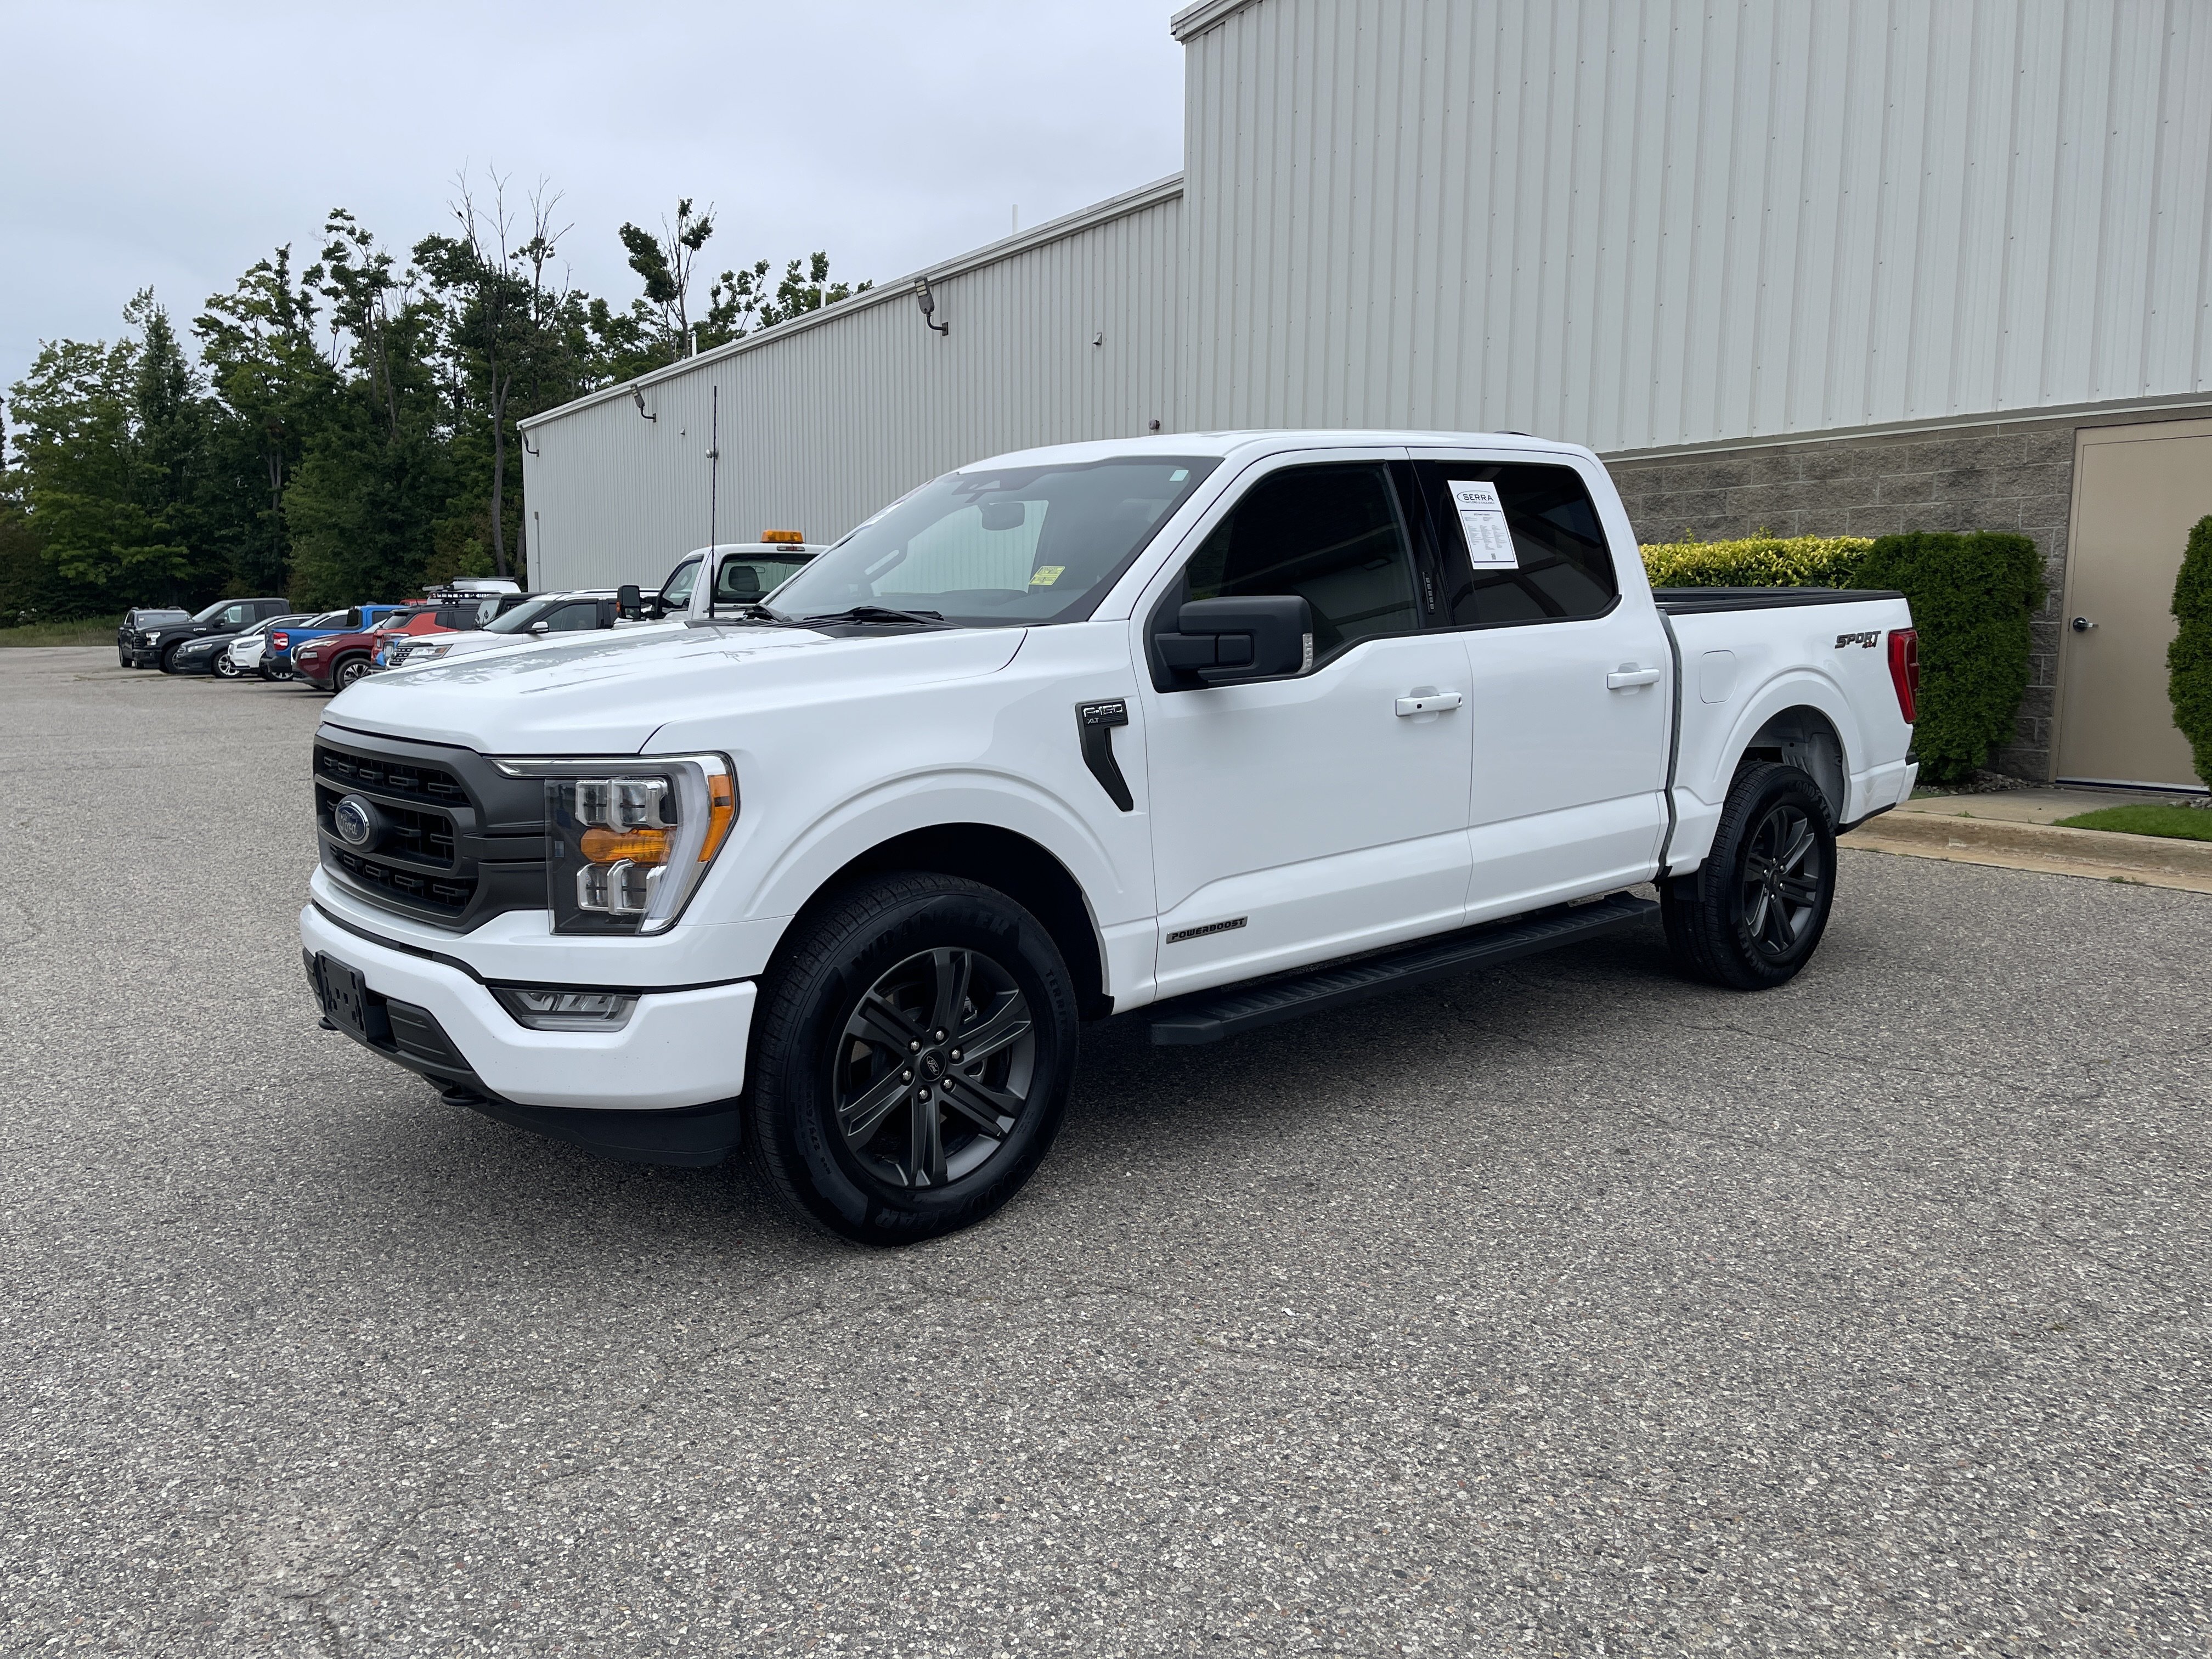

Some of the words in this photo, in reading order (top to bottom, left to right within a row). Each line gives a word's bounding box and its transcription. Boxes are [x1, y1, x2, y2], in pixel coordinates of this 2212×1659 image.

[1835, 630, 1882, 649] SPORT
[1083, 704, 1123, 718] F-150
[340, 809, 358, 836] Ford
[1171, 918, 1245, 940] POWERBOOST
